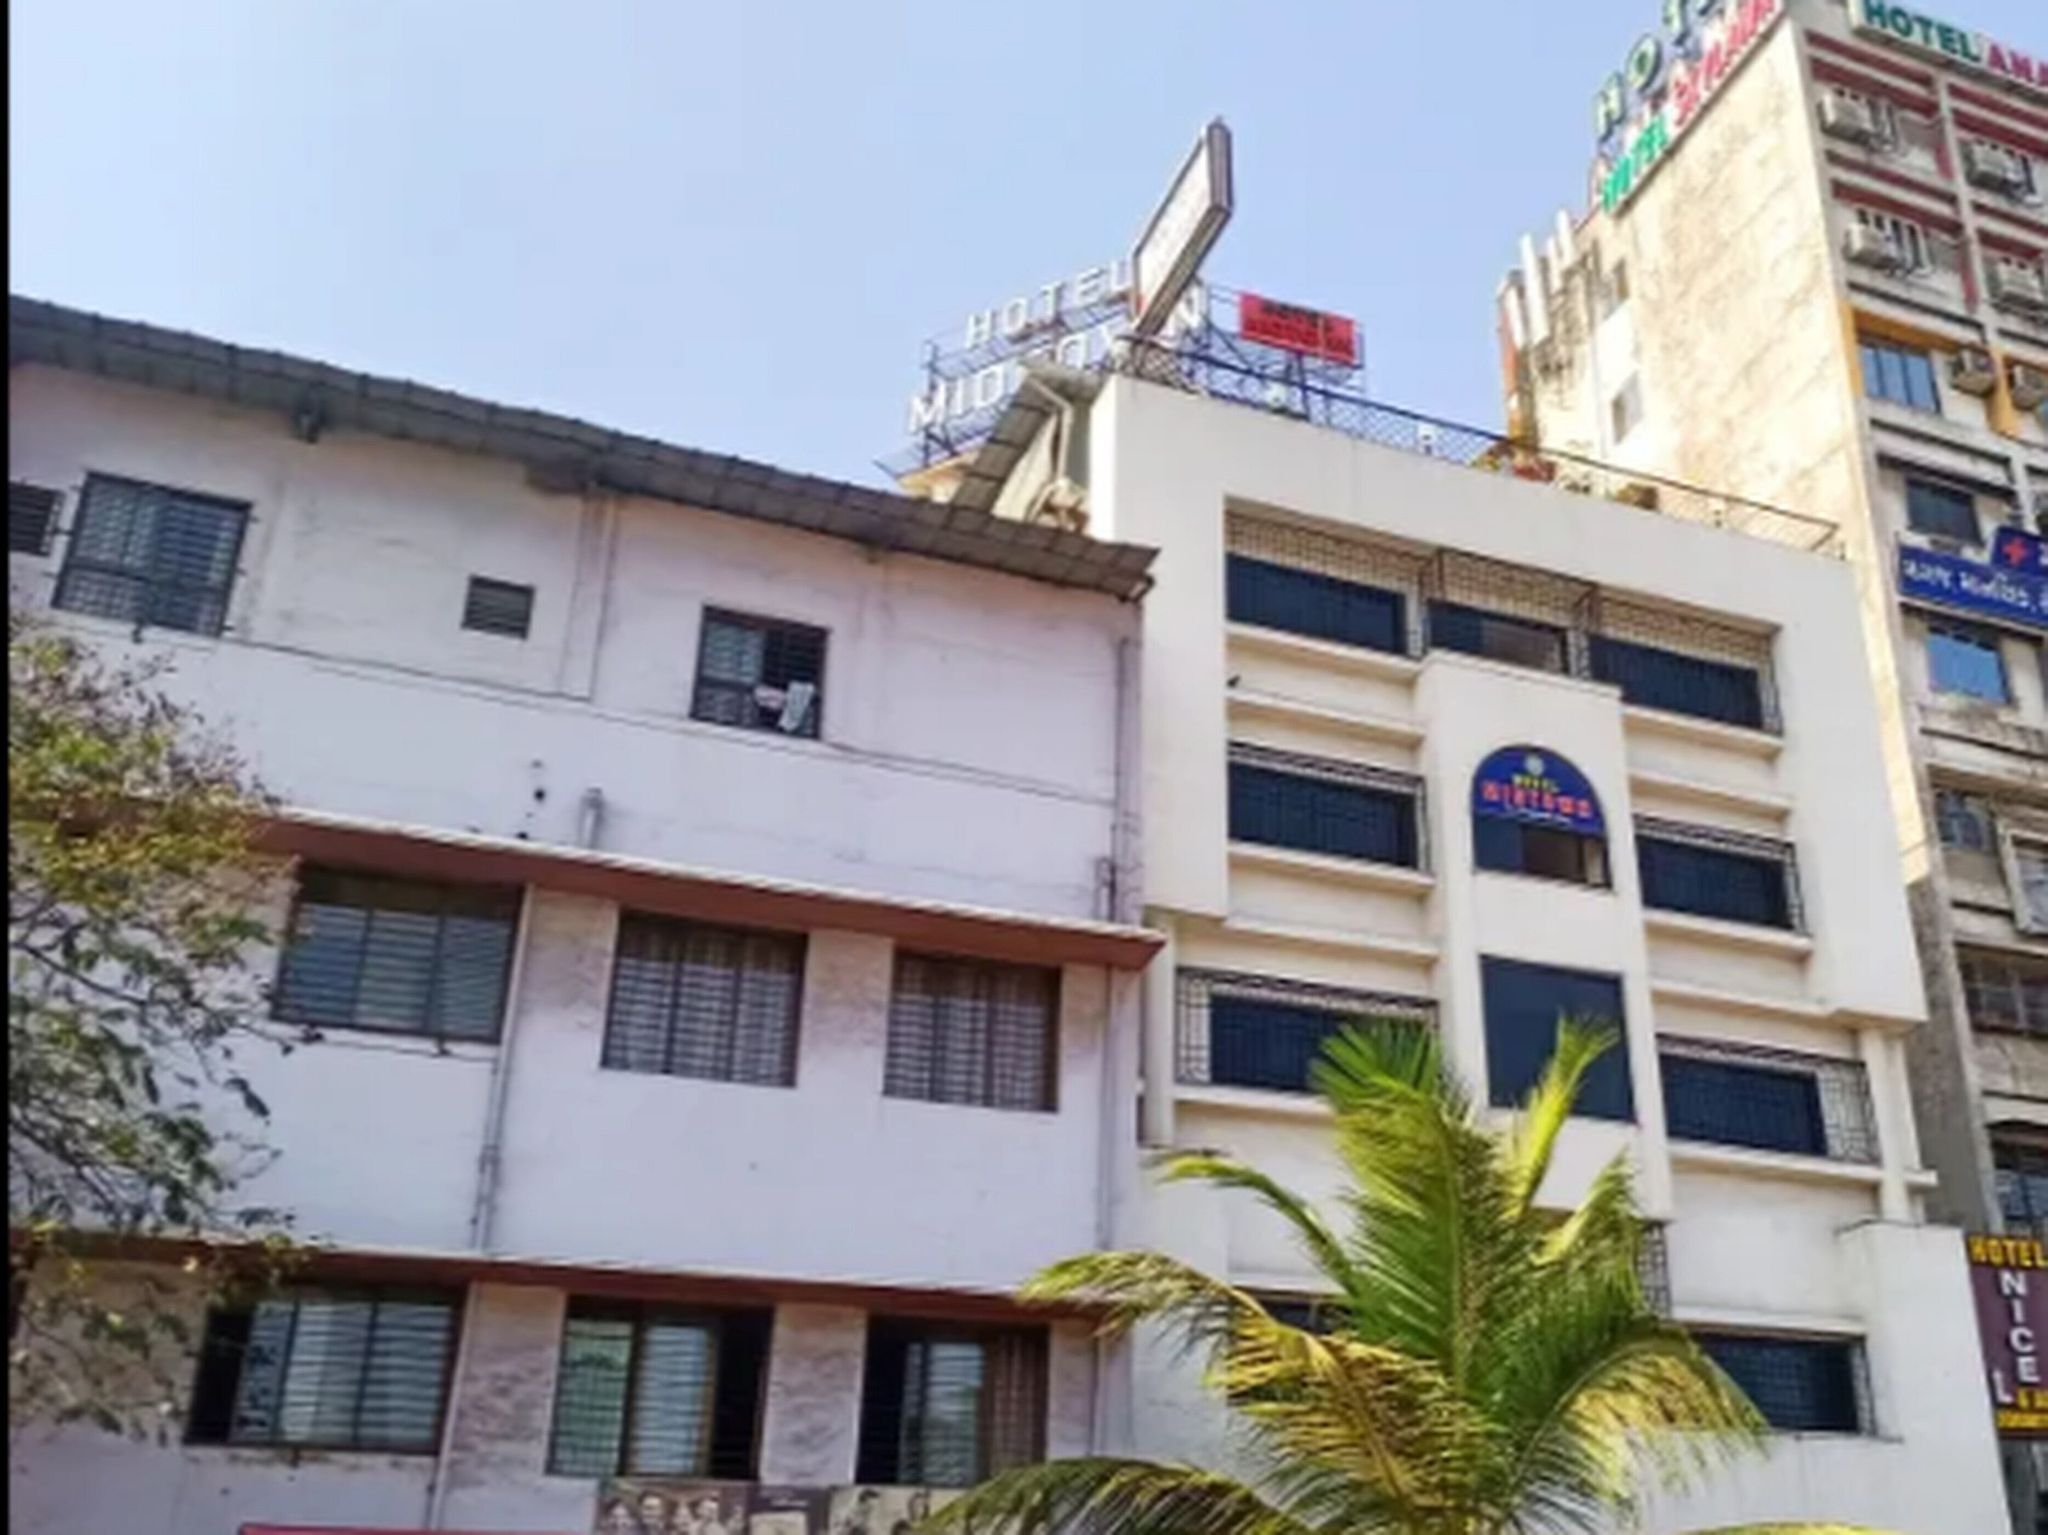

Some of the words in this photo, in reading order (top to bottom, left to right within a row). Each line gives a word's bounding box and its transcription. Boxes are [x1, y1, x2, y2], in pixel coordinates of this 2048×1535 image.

[1863, 0, 1981, 63] HOTEL
[964, 257, 1134, 349] HOTEL
[908, 278, 1208, 434] MIDON
[1969, 1235, 2048, 1268] HOTEL
[2000, 1271, 2041, 1383] NICE
